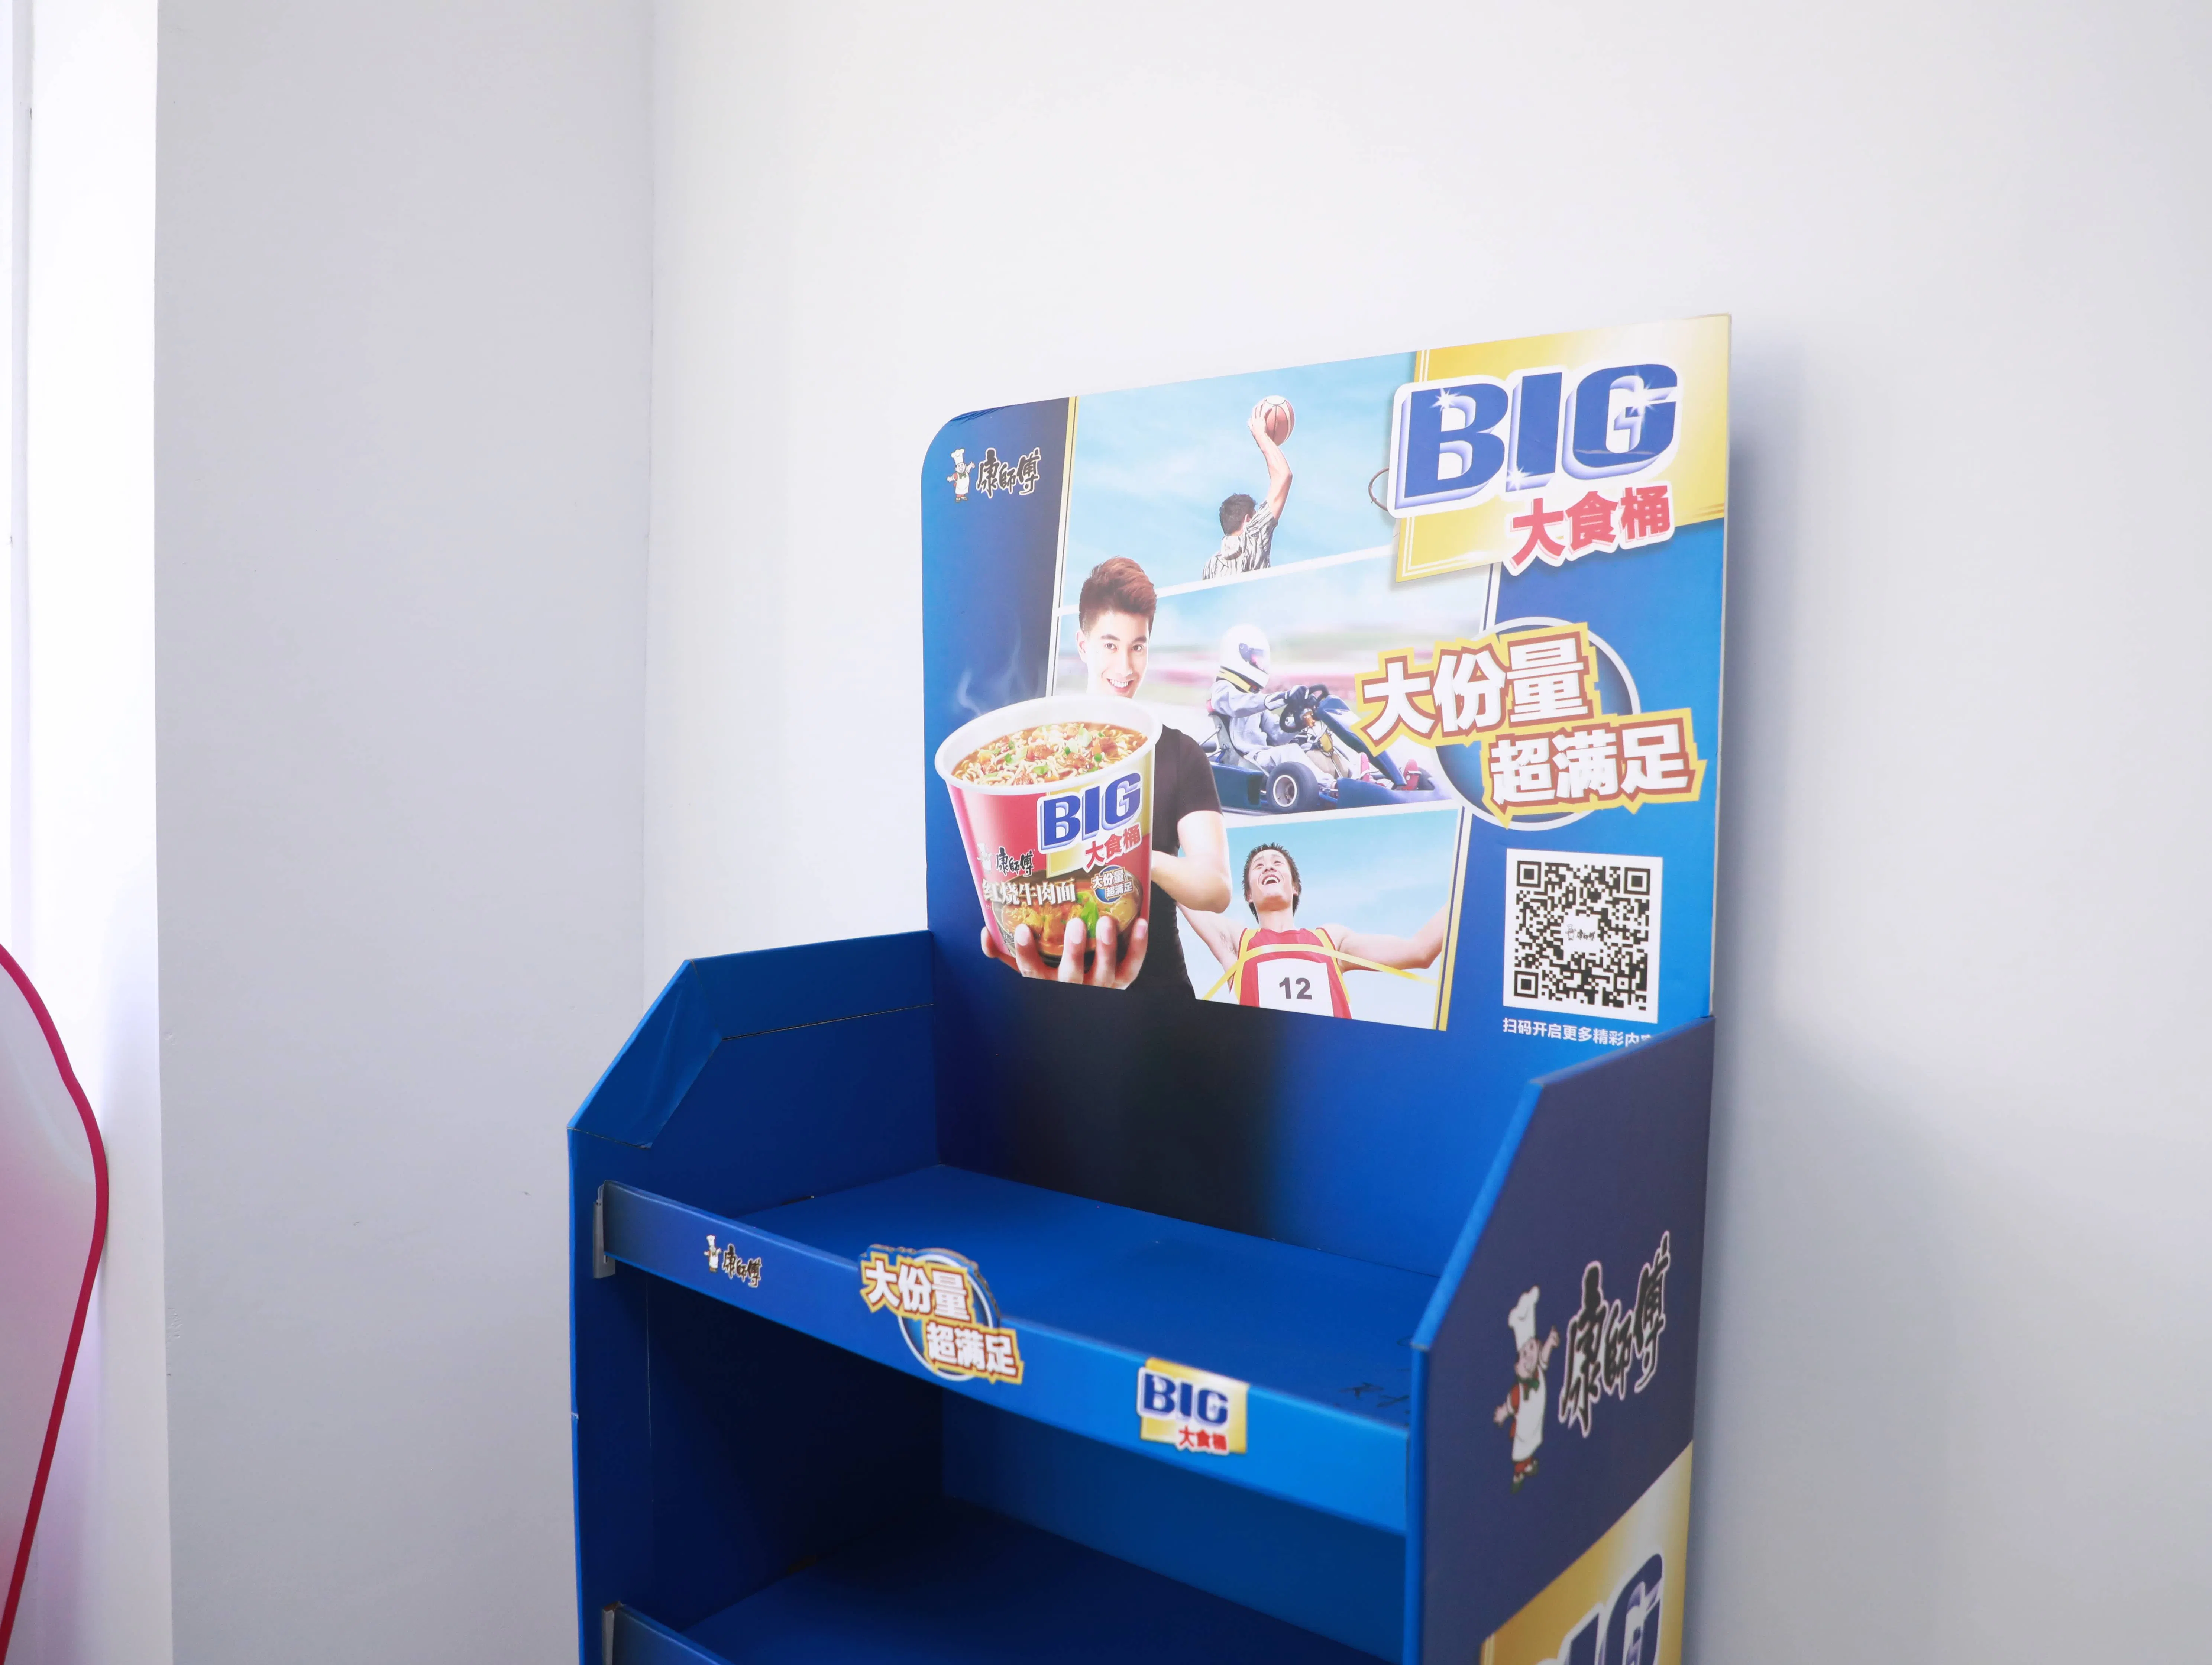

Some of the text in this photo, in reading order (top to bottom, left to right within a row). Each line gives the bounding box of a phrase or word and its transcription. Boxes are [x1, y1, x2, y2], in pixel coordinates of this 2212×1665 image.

[1395, 364, 1678, 509] BIG
[976, 447, 1041, 499] 康師傅
[1510, 485, 1671, 568] 大食桶
[1363, 637, 1589, 740] 大份量
[1490, 724, 1688, 804] 超满足
[1041, 772, 1141, 850] BIG
[1085, 824, 1141, 869] 大食桶
[982, 877, 1076, 906] 红烧牛肉面
[1092, 869, 1125, 889] 大份量
[1106, 881, 1133, 898] 超满足
[1279, 977, 1312, 1000] 12
[865, 1260, 971, 1321] 大份量
[925, 1321, 1016, 1376] 超满足
[1140, 1373, 1228, 1427] BIG
